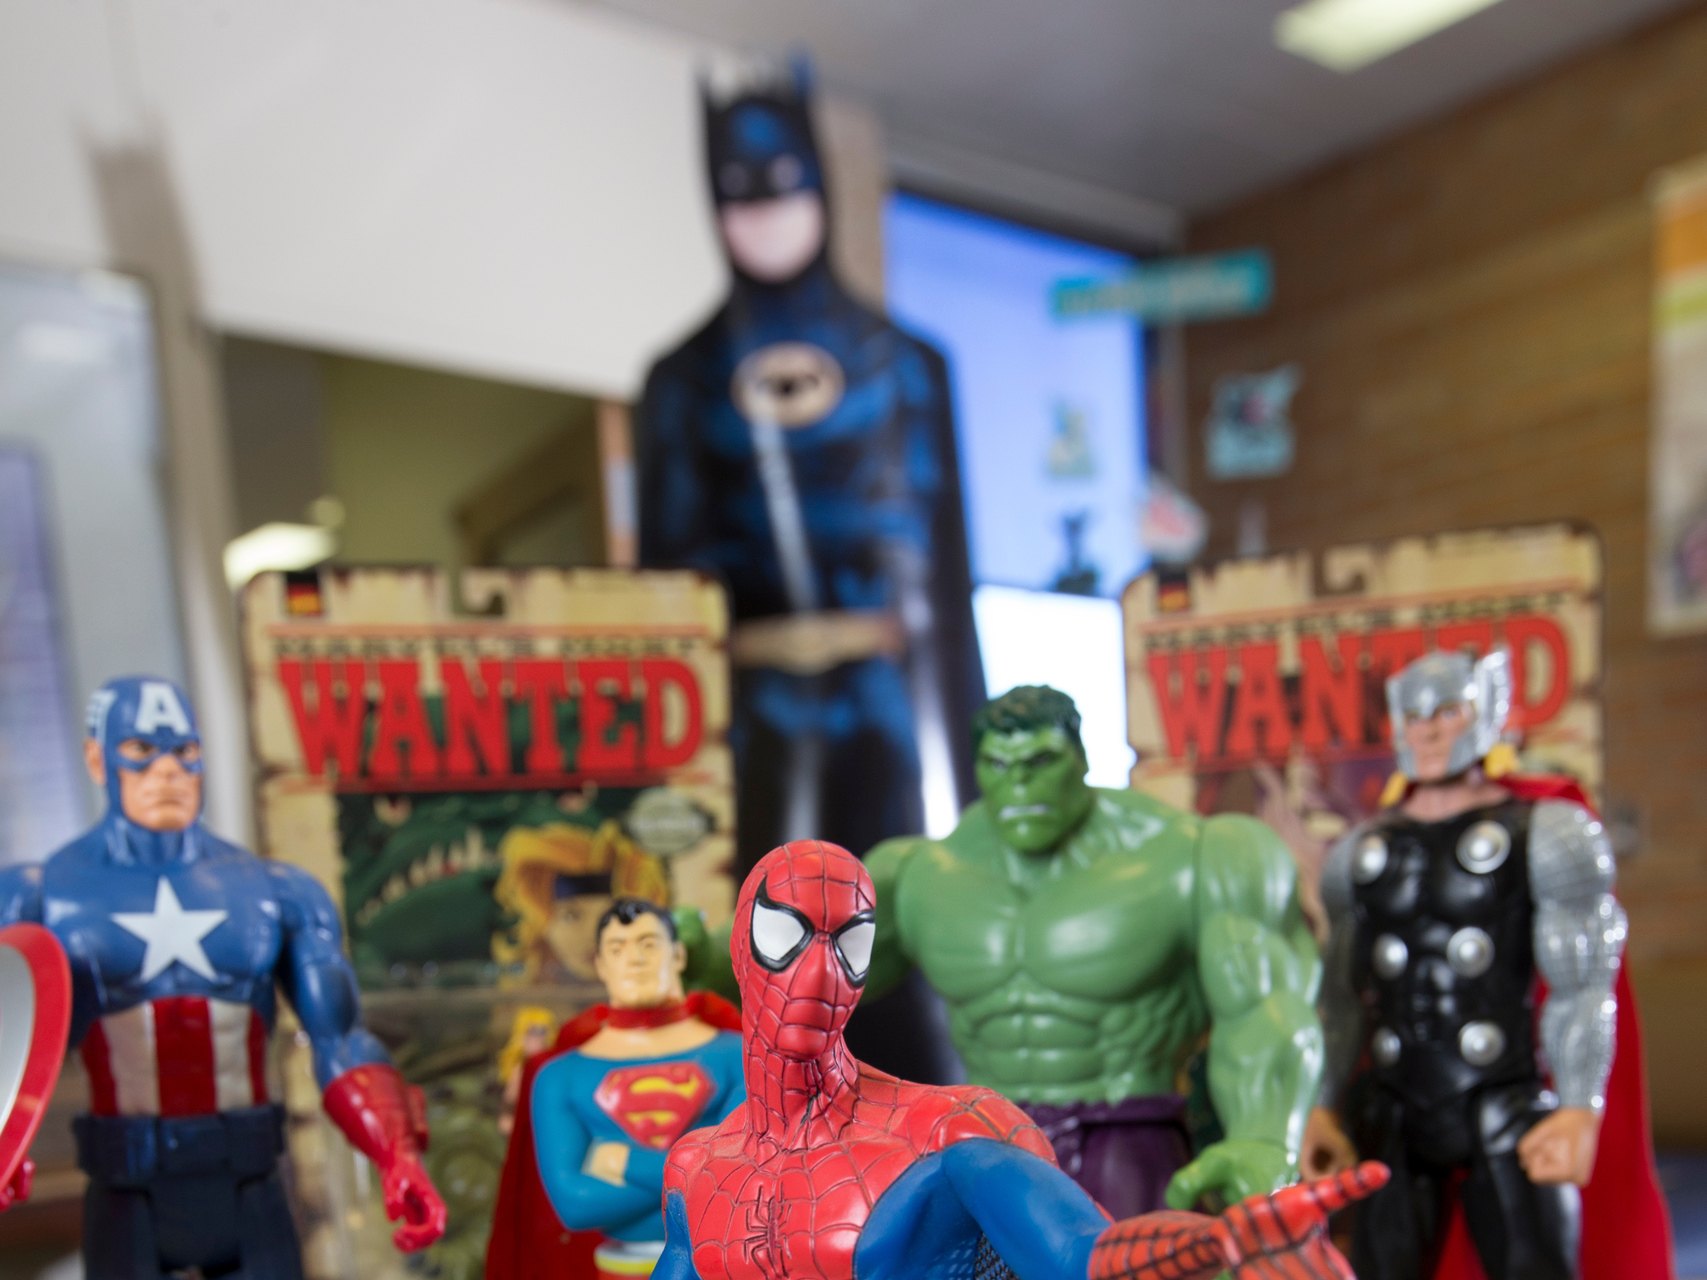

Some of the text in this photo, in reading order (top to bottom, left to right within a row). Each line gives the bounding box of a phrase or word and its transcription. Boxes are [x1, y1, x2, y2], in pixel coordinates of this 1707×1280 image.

[135, 683, 191, 735] A
[276, 658, 704, 780] WANTED
[1147, 612, 1569, 758] WANTD
